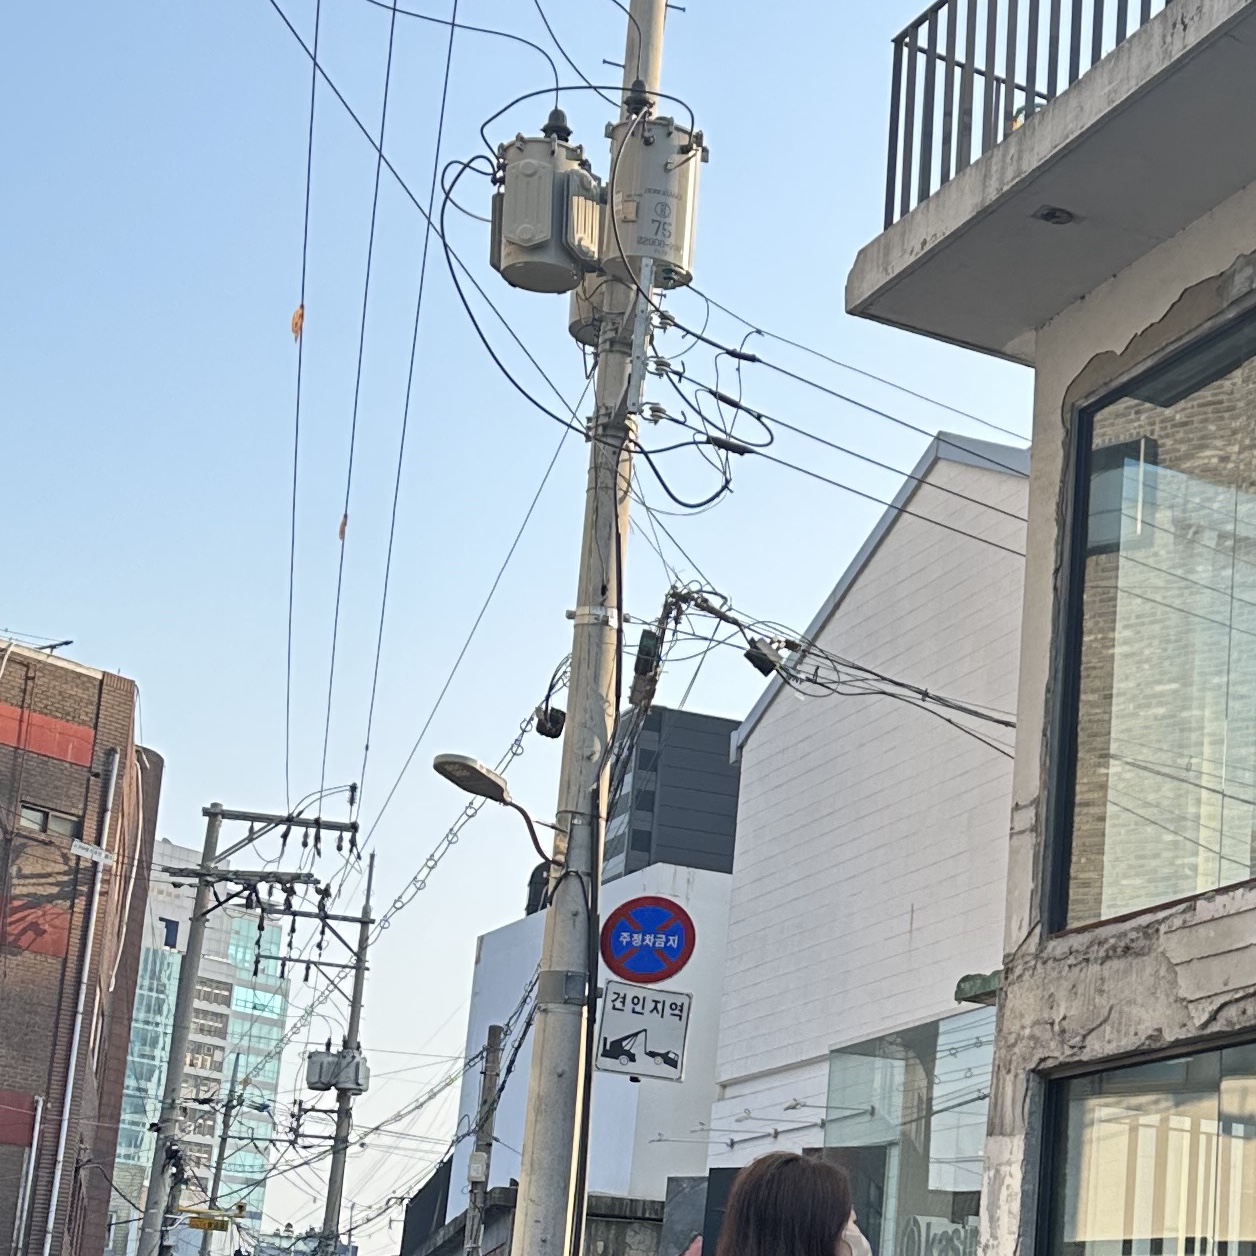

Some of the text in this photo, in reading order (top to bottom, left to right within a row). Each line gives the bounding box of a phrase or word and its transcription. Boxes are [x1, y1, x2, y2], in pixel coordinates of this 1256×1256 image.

[651, 219, 672, 239] 75
[618, 932, 678, 948] 주정차금지
[611, 991, 684, 1021] 견인지역
